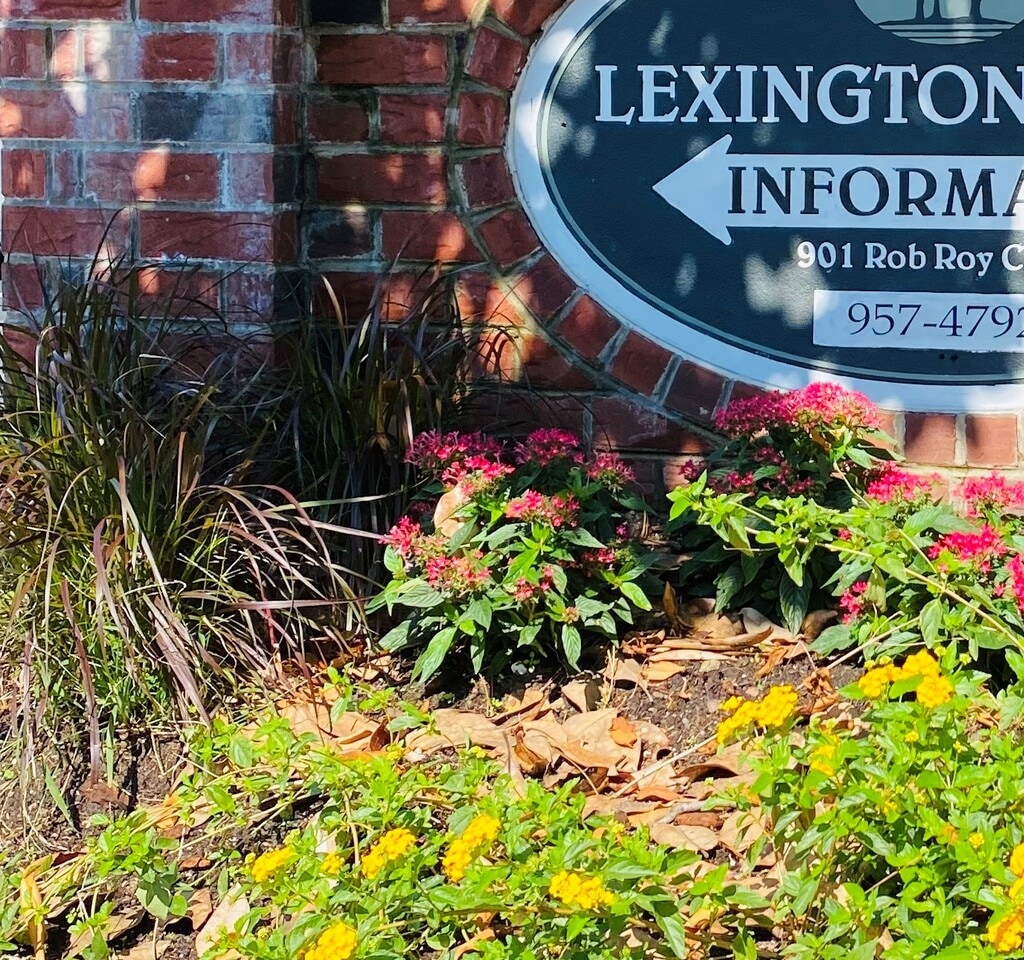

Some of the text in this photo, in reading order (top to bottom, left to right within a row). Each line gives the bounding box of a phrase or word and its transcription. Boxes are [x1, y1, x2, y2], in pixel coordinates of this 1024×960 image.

[797, 241, 854, 273] 901
[865, 241, 927, 272] Rob
[933, 244, 994, 277] Roy
